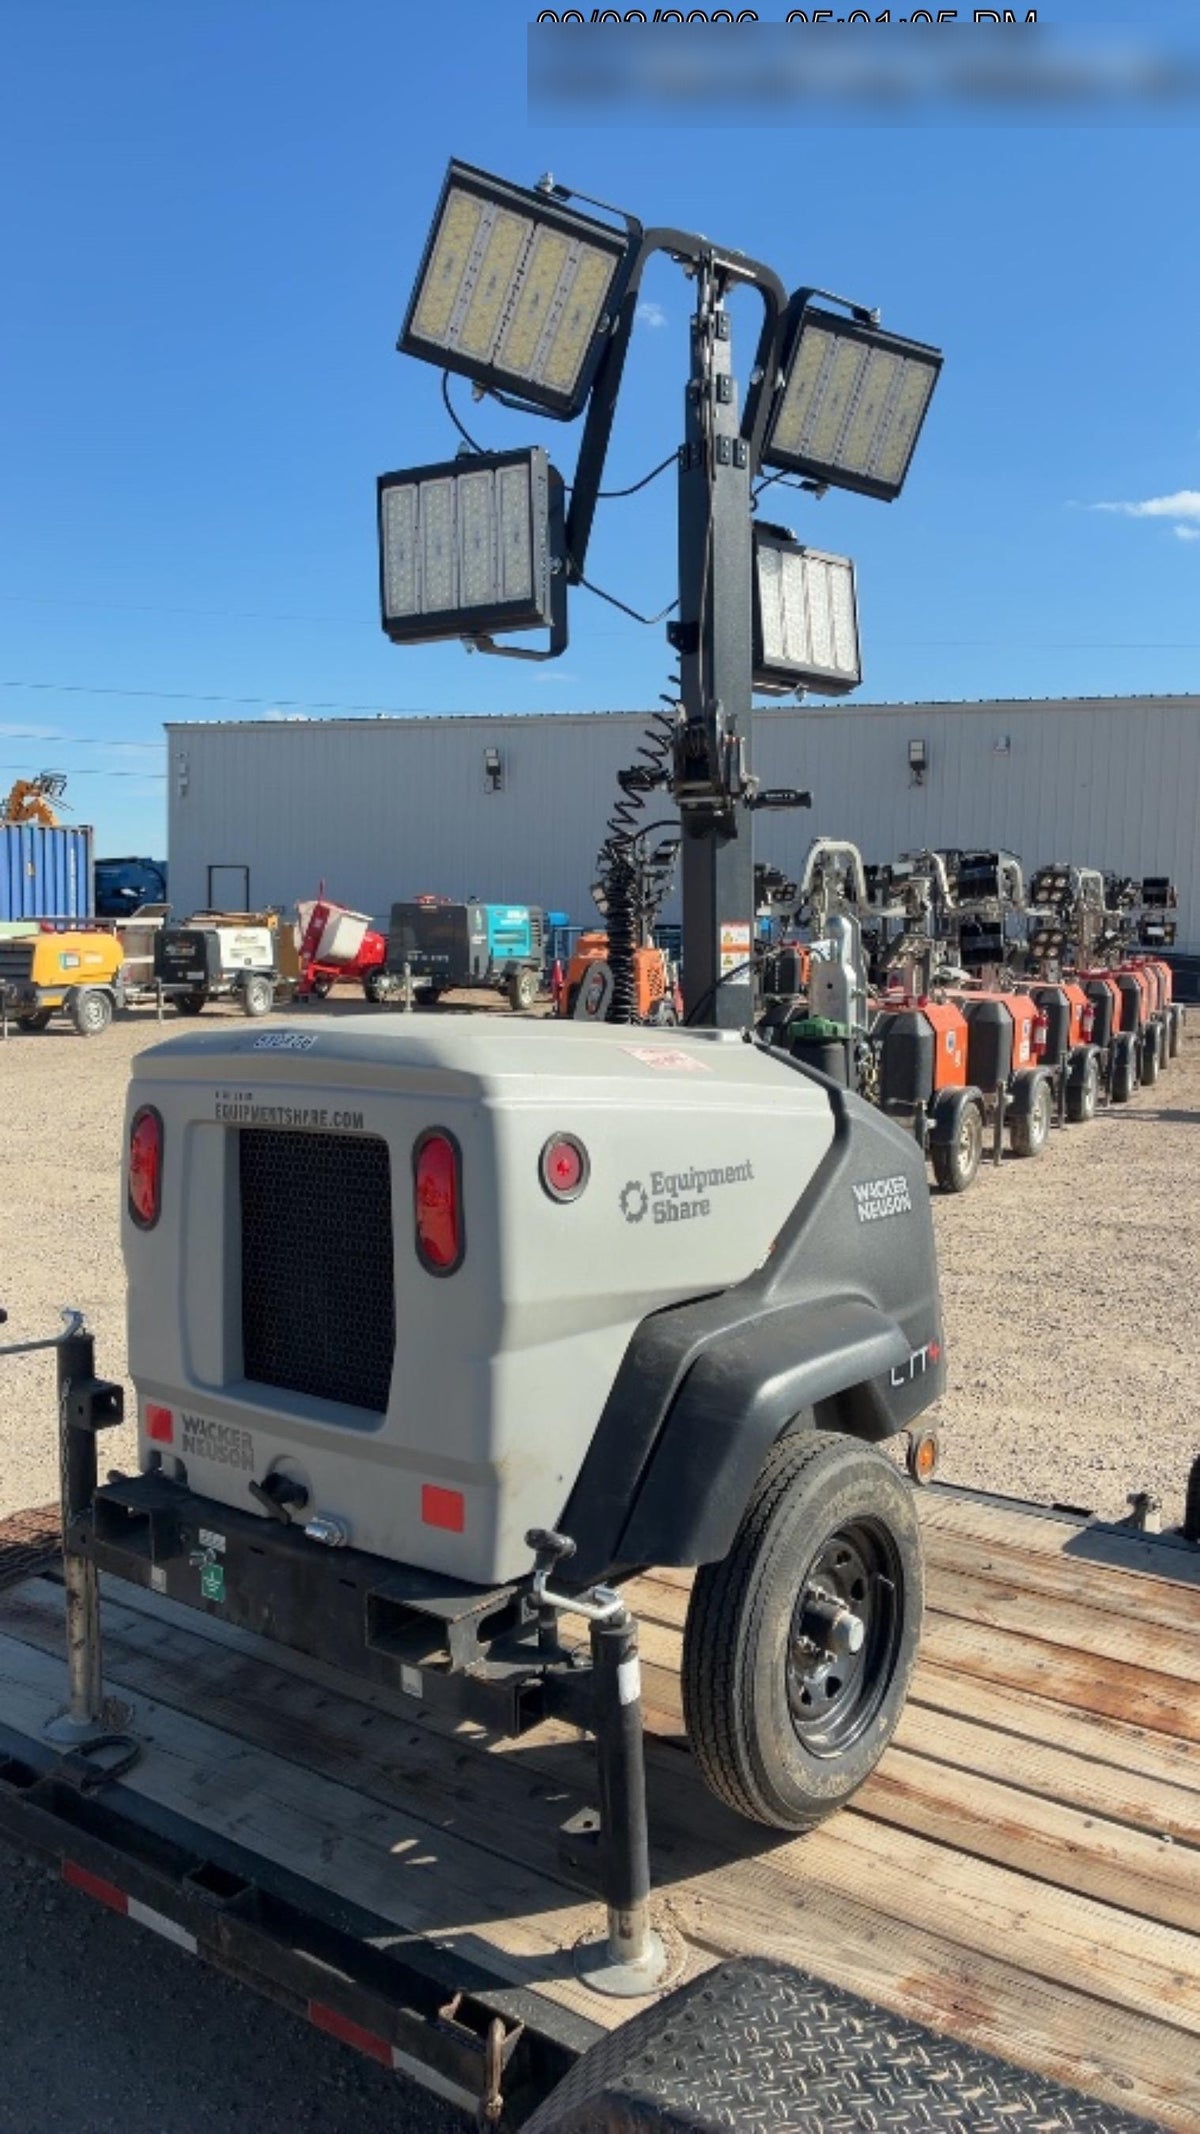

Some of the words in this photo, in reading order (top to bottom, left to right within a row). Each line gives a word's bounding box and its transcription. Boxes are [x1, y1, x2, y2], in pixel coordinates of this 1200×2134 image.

[650, 1159, 754, 1198] Equipment
[851, 1175, 908, 1202] WACKER
[652, 1199, 710, 1224] Share
[858, 1191, 911, 1222] NEUSON
[181, 1413, 253, 1451] WACKER
[181, 1433, 255, 1472] NEUSON
